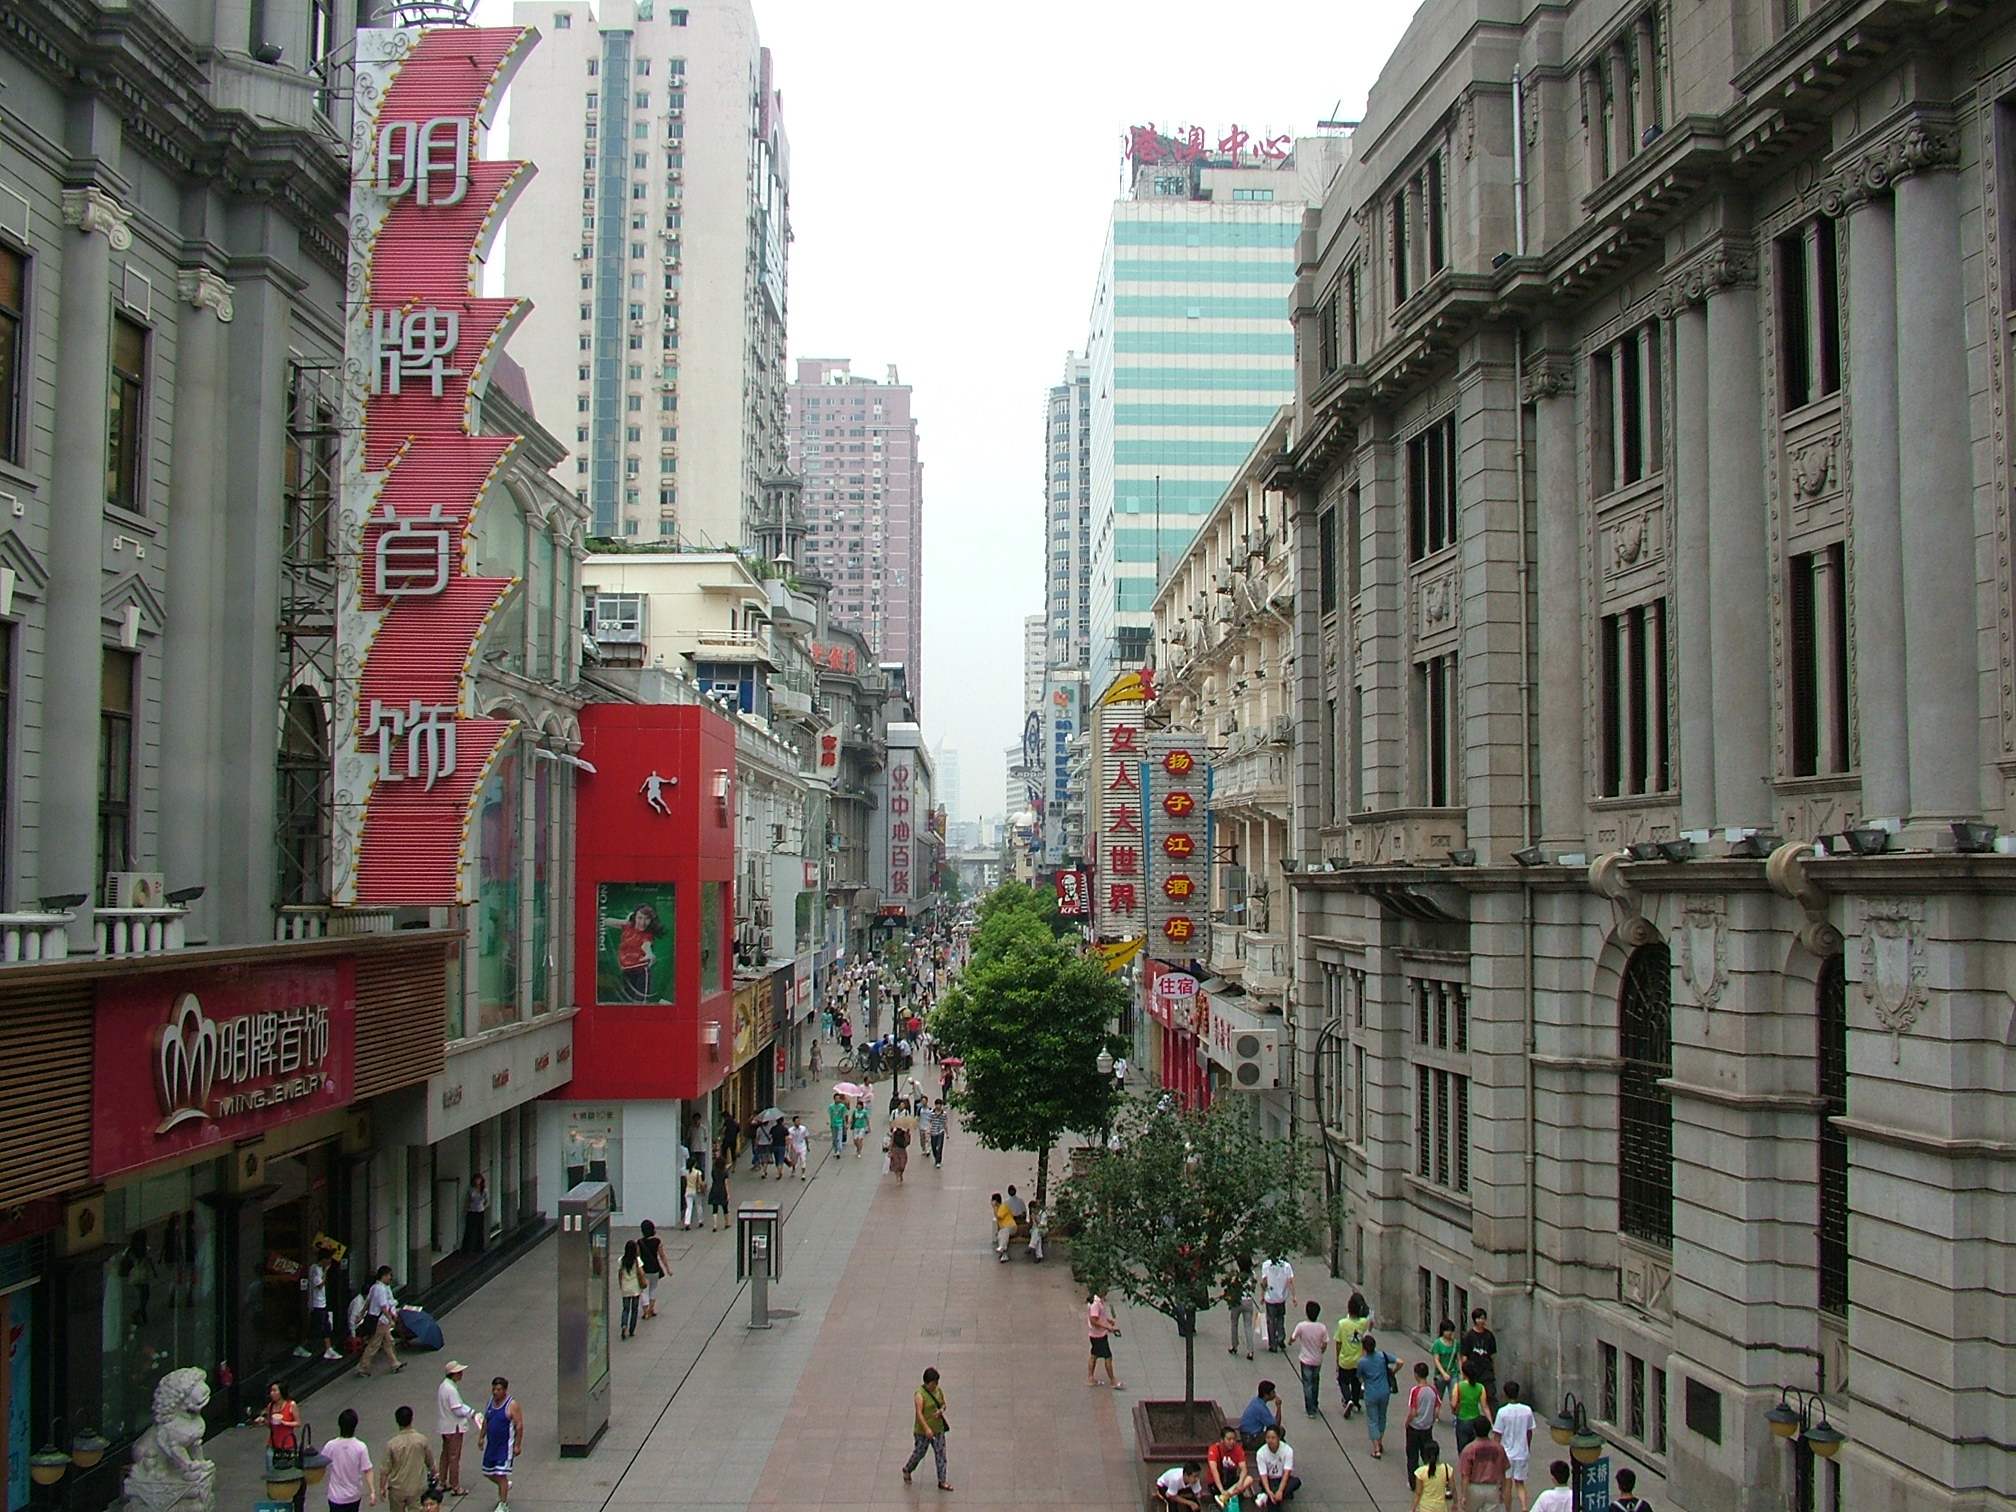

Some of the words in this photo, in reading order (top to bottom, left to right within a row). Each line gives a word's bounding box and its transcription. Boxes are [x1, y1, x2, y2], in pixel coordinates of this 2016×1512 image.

[364, 117, 470, 793] 明牌首饰
[1108, 723, 1138, 914] 女人大世界
[1166, 753, 1191, 938] 扬子江酒店
[1060, 906, 1080, 915] KFC
[1158, 977, 1194, 995] 住宿
[219, 1004, 329, 1085] 明牌首饰
[219, 1089, 266, 1118] MING
[267, 1071, 329, 1106] JEWELRY
[1586, 1463, 1608, 1486] 天桥
[1584, 1489, 1608, 1511] 下行
